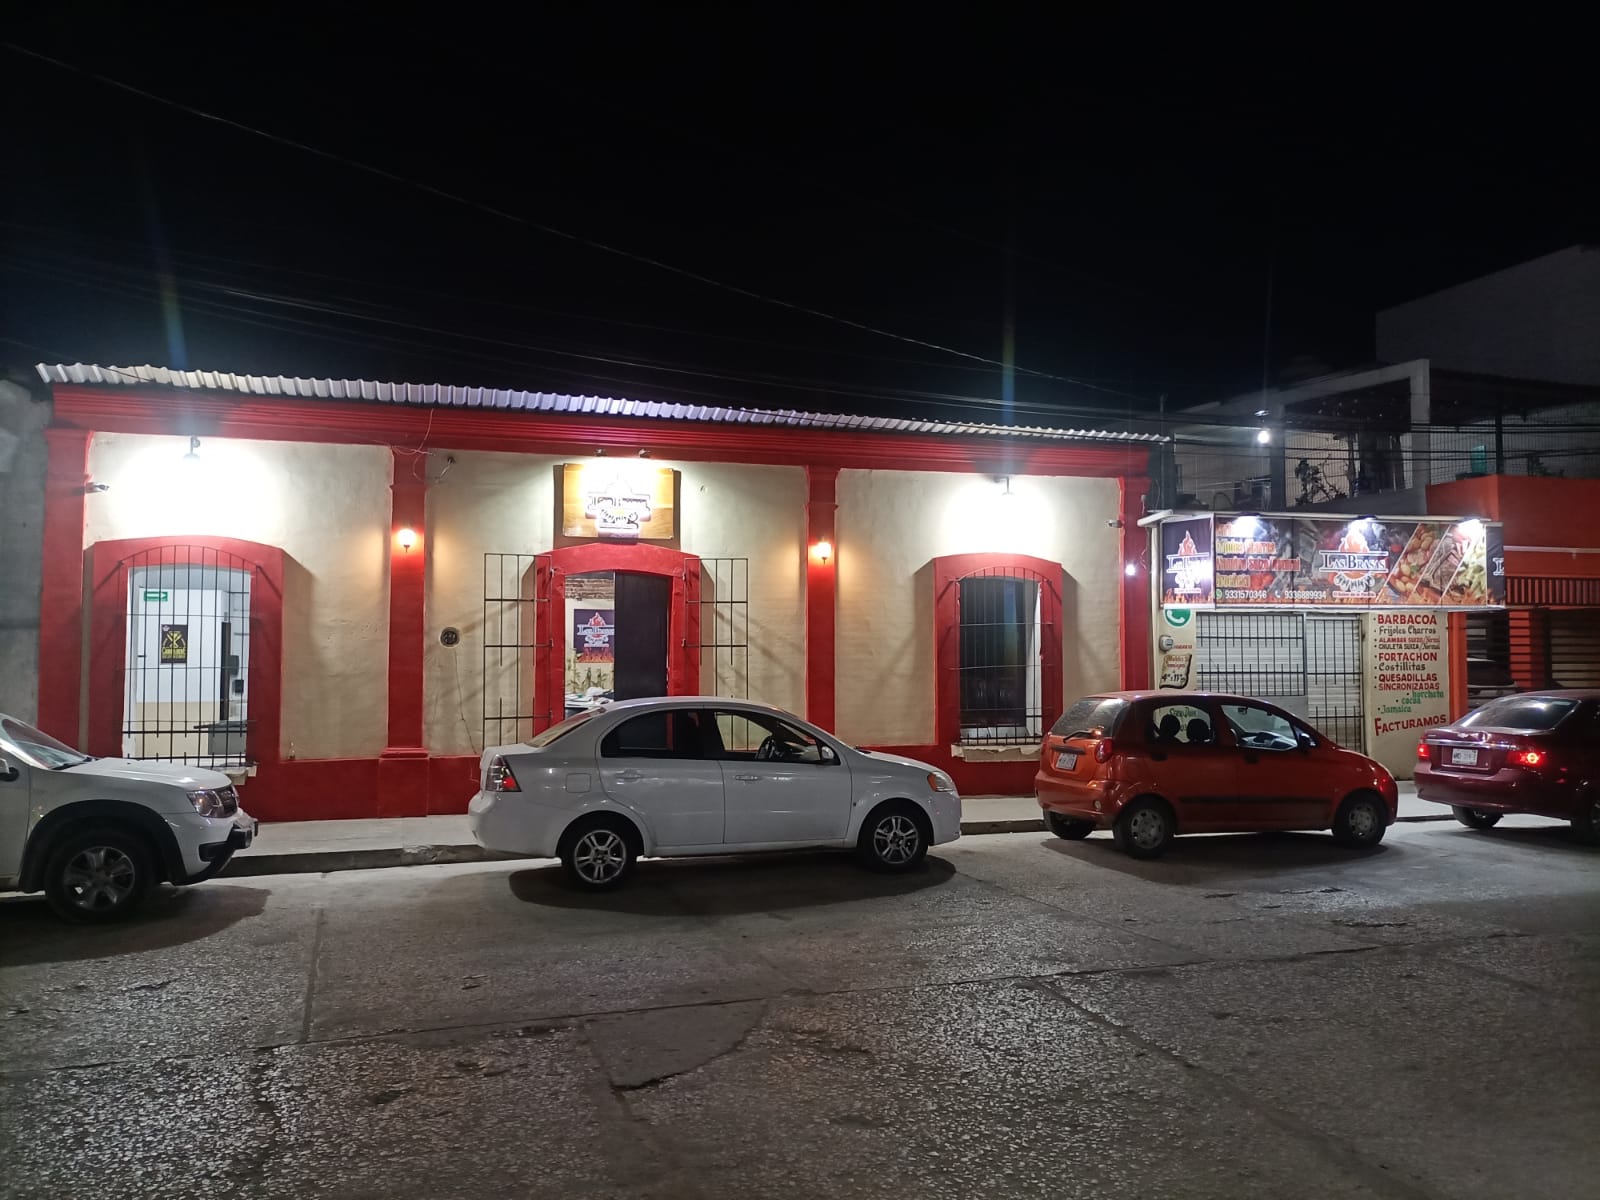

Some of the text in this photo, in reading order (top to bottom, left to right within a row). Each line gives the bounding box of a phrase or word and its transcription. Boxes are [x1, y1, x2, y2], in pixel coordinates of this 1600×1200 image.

[1322, 554, 1386, 569] LAS BRASAS
[1377, 614, 1437, 625] BARBACOA
[1379, 624, 1437, 636] Frijoles Charros
[1378, 652, 1438, 662] FORTACHON
[1378, 661, 1426, 672] Costillitas
[1378, 673, 1438, 682] QUESADILLAS
[1378, 682, 1441, 691] SINCRONIZADAS
[1381, 704, 1412, 714] Jamaica
[1374, 714, 1447, 736] FACTURAMOS
